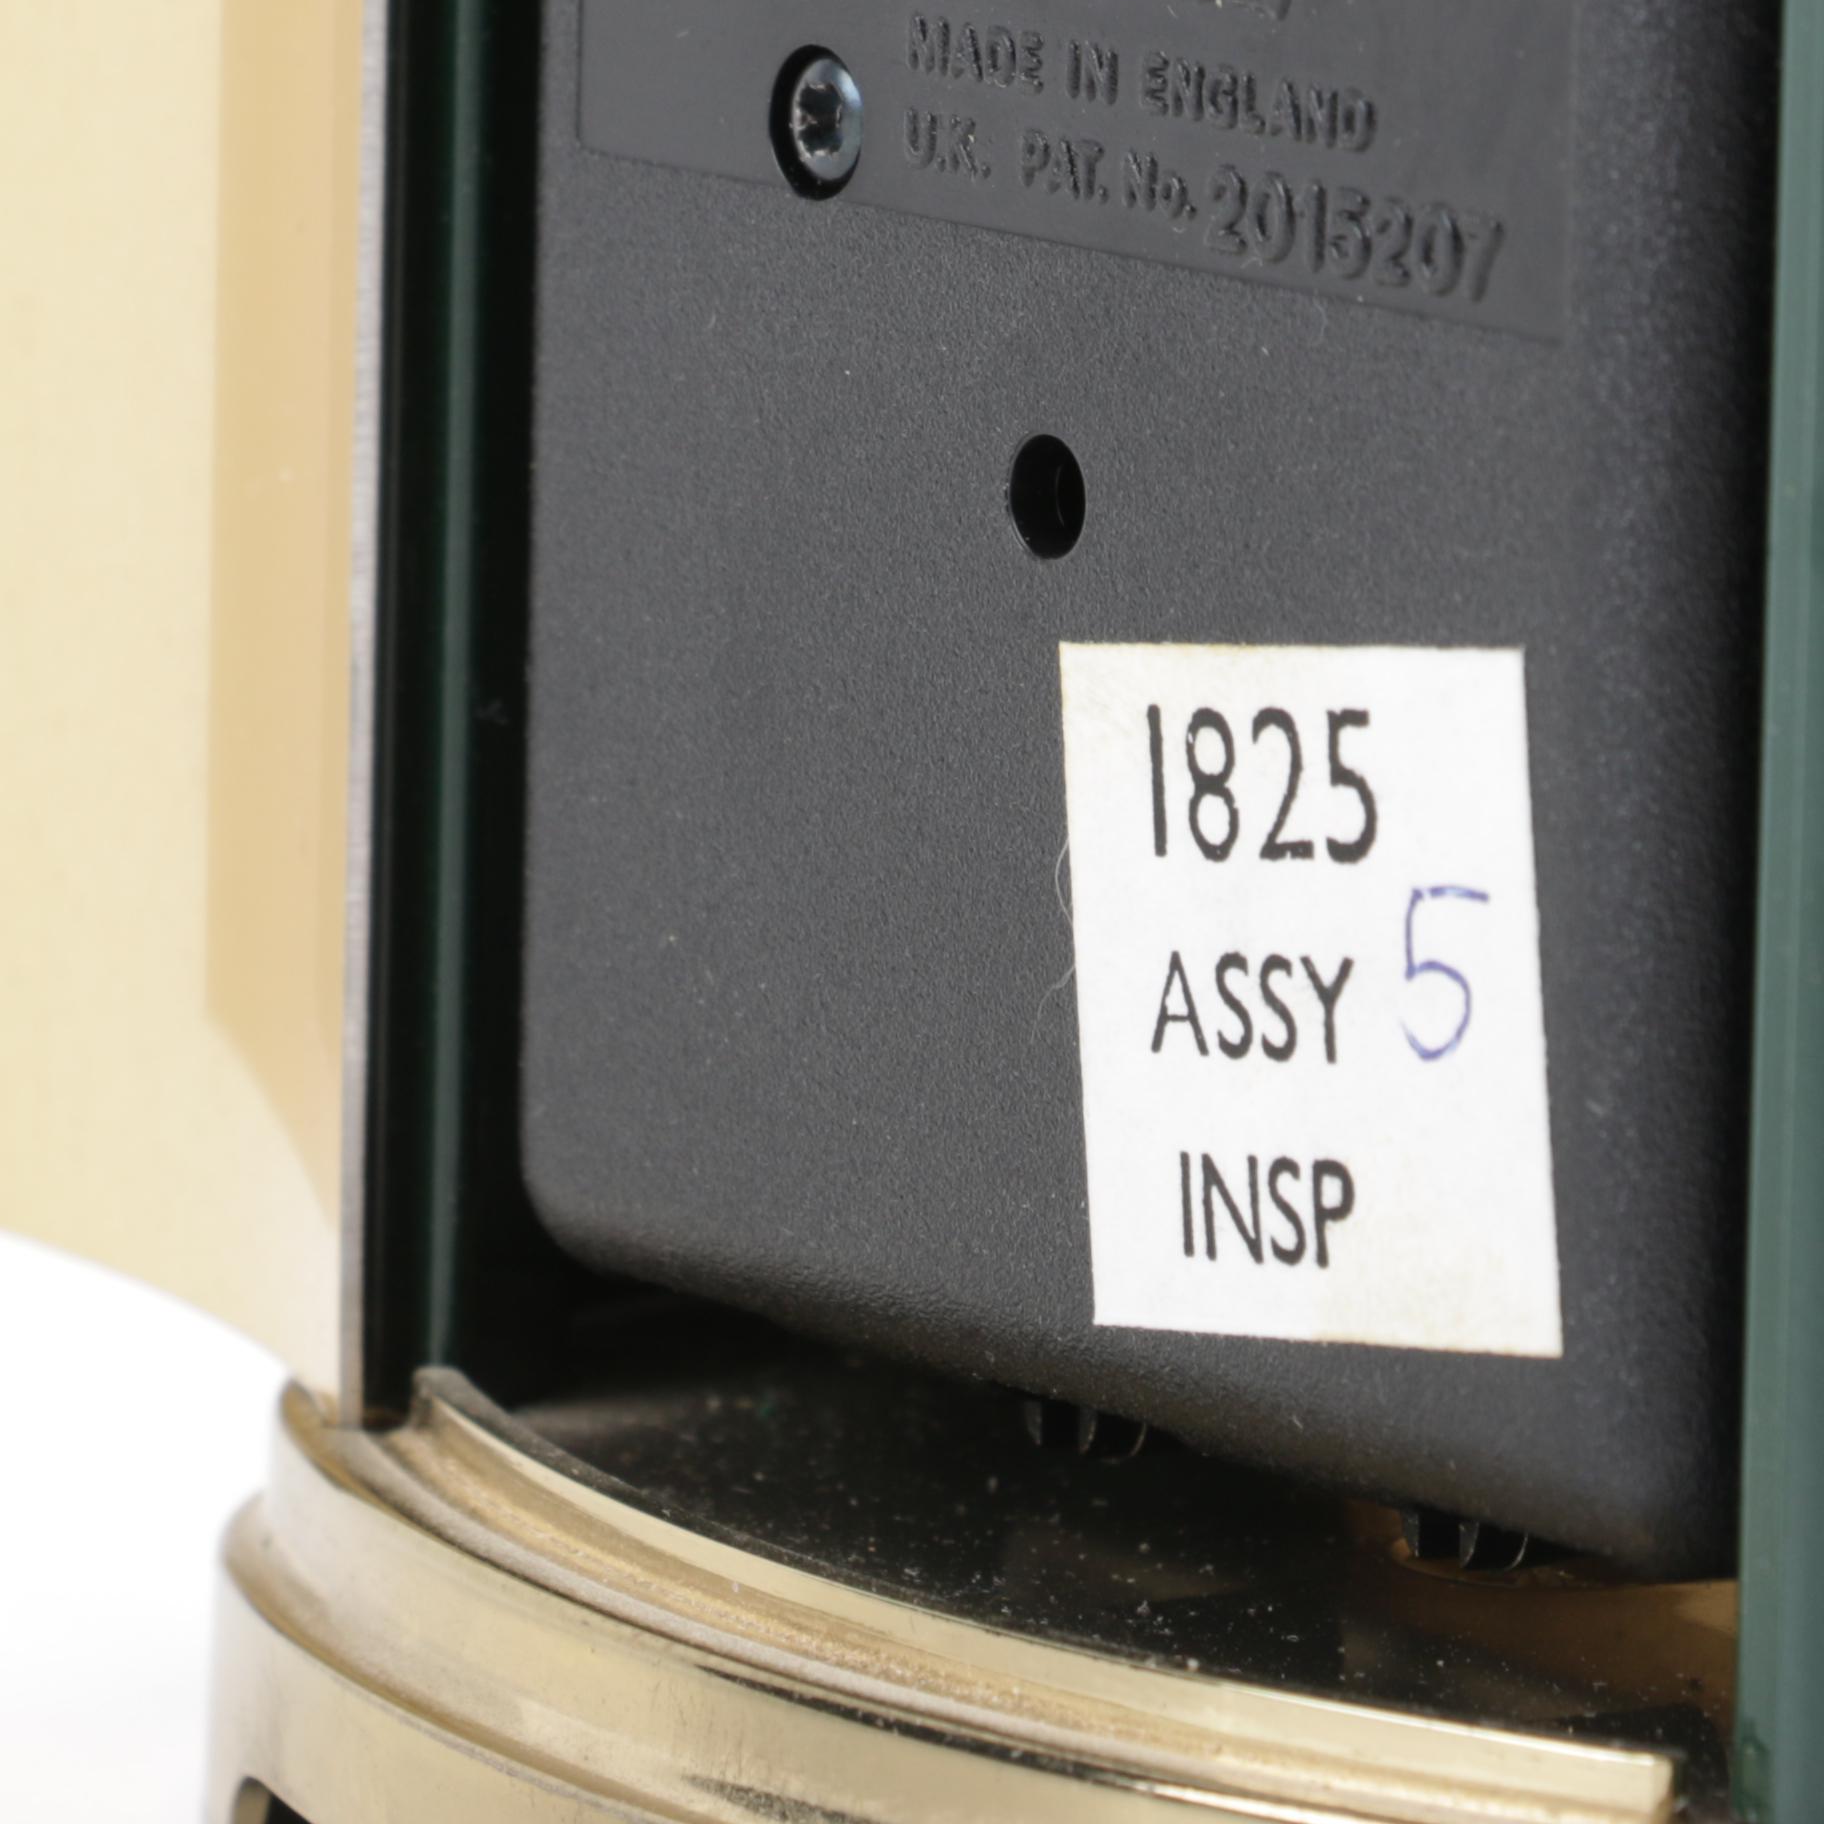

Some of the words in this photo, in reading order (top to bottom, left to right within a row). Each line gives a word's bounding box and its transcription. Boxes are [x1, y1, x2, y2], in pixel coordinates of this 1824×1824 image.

[907, 12, 1045, 94] MADE
[1067, 40, 1119, 105] IN
[1140, 51, 1376, 153] ENGLAND
[905, 108, 990, 179] U.K.
[1021, 130, 1109, 205] PAT.
[1147, 704, 1377, 863] 1825
[1151, 950, 1354, 1064] ASSY
[1400, 886, 1490, 1061] 5
[1180, 1151, 1355, 1269] INSP
